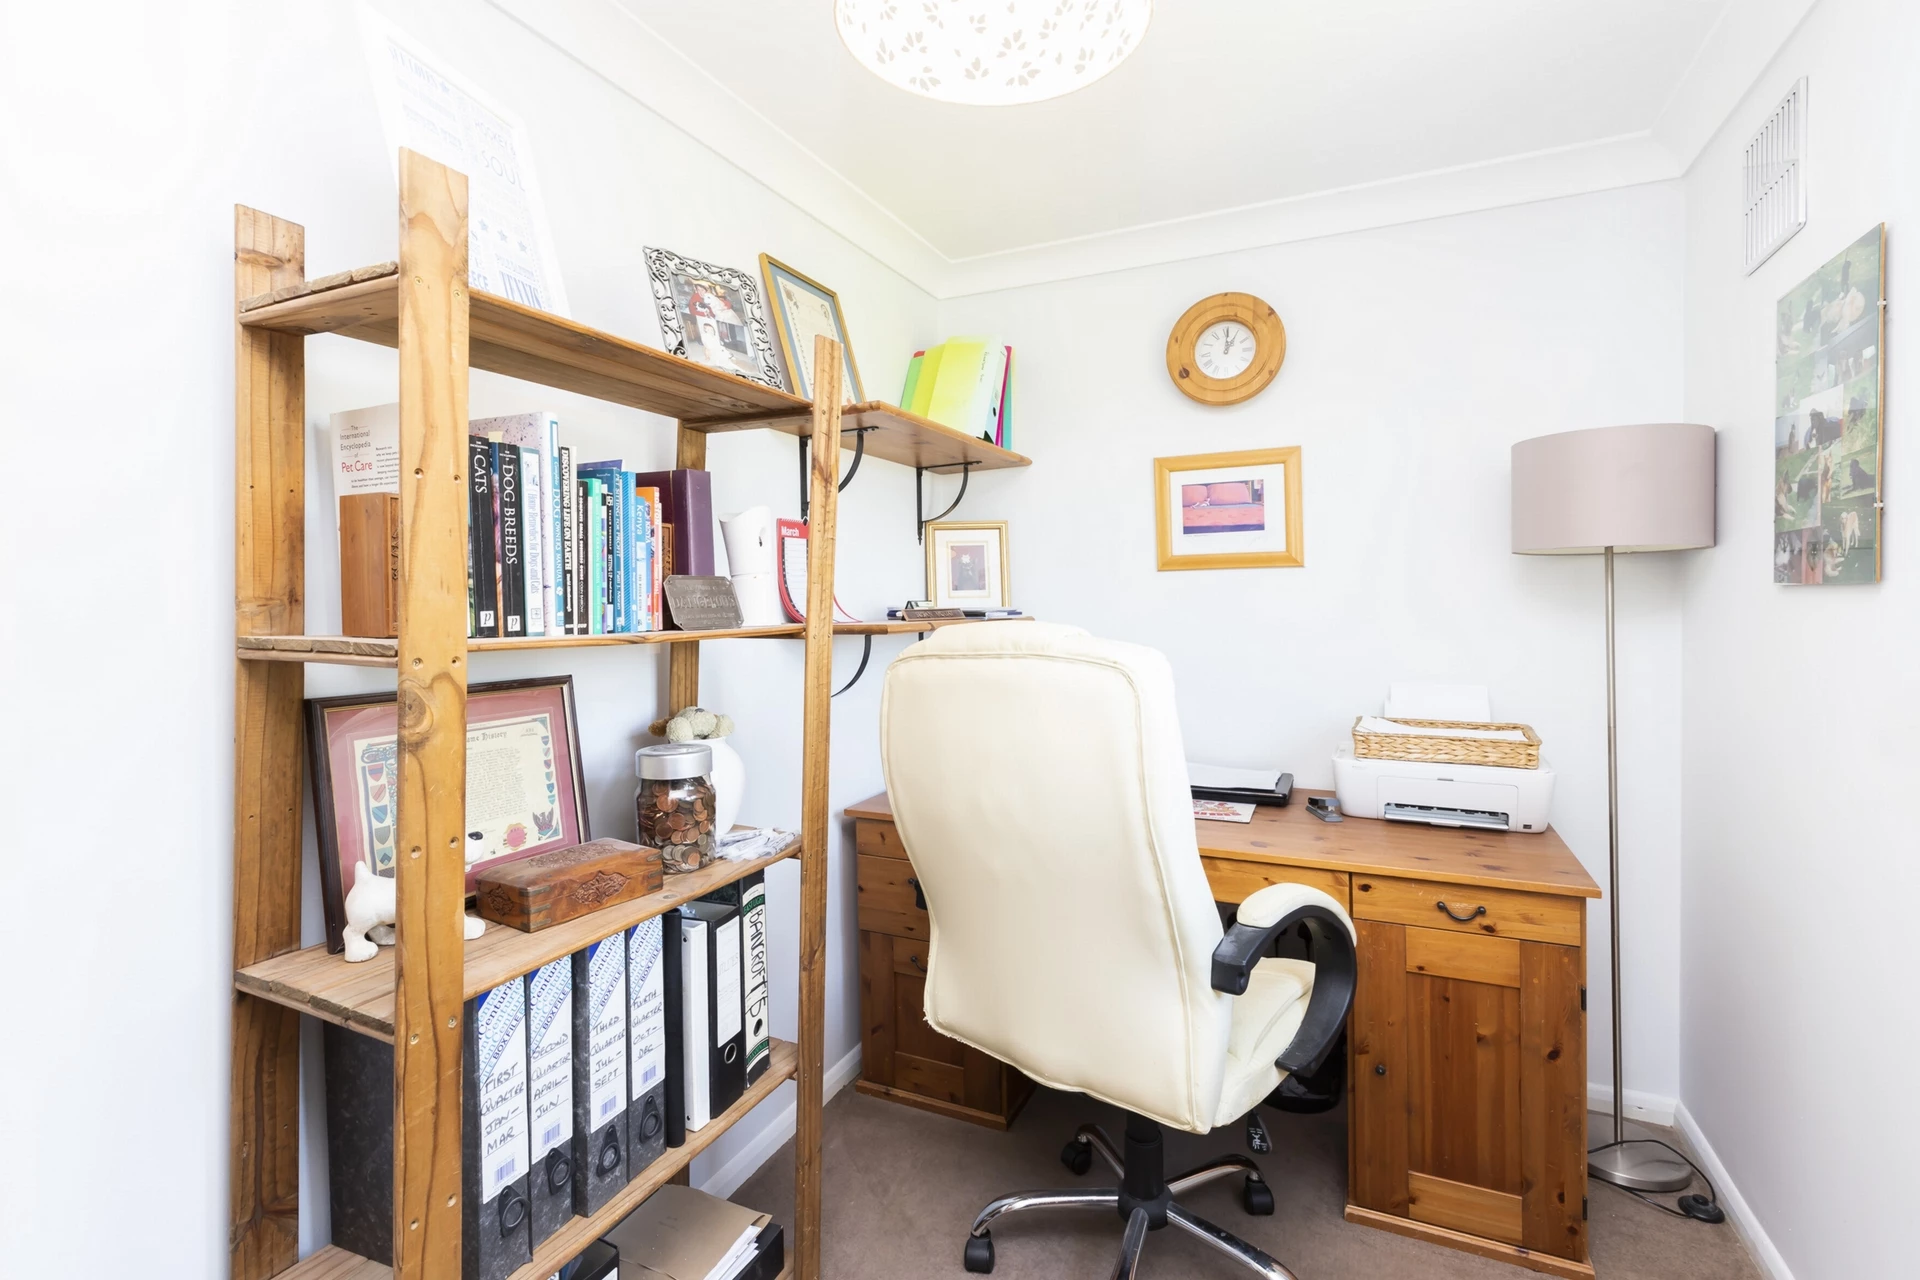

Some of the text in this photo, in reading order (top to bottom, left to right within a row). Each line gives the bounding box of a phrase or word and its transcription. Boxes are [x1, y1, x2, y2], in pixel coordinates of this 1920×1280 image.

[481, 150, 525, 192] SOUL
[340, 430, 370, 440] International
[340, 441, 371, 451] Encyclopedia
[341, 460, 372, 473] Pet Care
[473, 454, 487, 494] CATS
[561, 449, 571, 507] DISCOVERING
[502, 464, 515, 502] DOG
[528, 493, 538, 512] Home
[552, 488, 561, 518] DOG
[636, 505, 644, 535] Kenya
[781, 526, 799, 537] March
[503, 508, 517, 565] BREEDS
[564, 527, 572, 540] ON
[528, 552, 539, 569] Dogs
[531, 582, 540, 594] Cats
[481, 731, 507, 741] History
[593, 1016, 620, 1036] THIRD
[532, 1033, 568, 1060] SECOND
[590, 1028, 625, 1056] QUARTER
[638, 1044, 653, 1059] DEC
[484, 1062, 518, 1094] FIRST
[532, 1052, 571, 1081] QUARTER
[594, 1068, 618, 1089] SEPT
[480, 1081, 524, 1117] QUARTER
[535, 1094, 560, 1119] JUN
[487, 1126, 515, 1155] MAR
